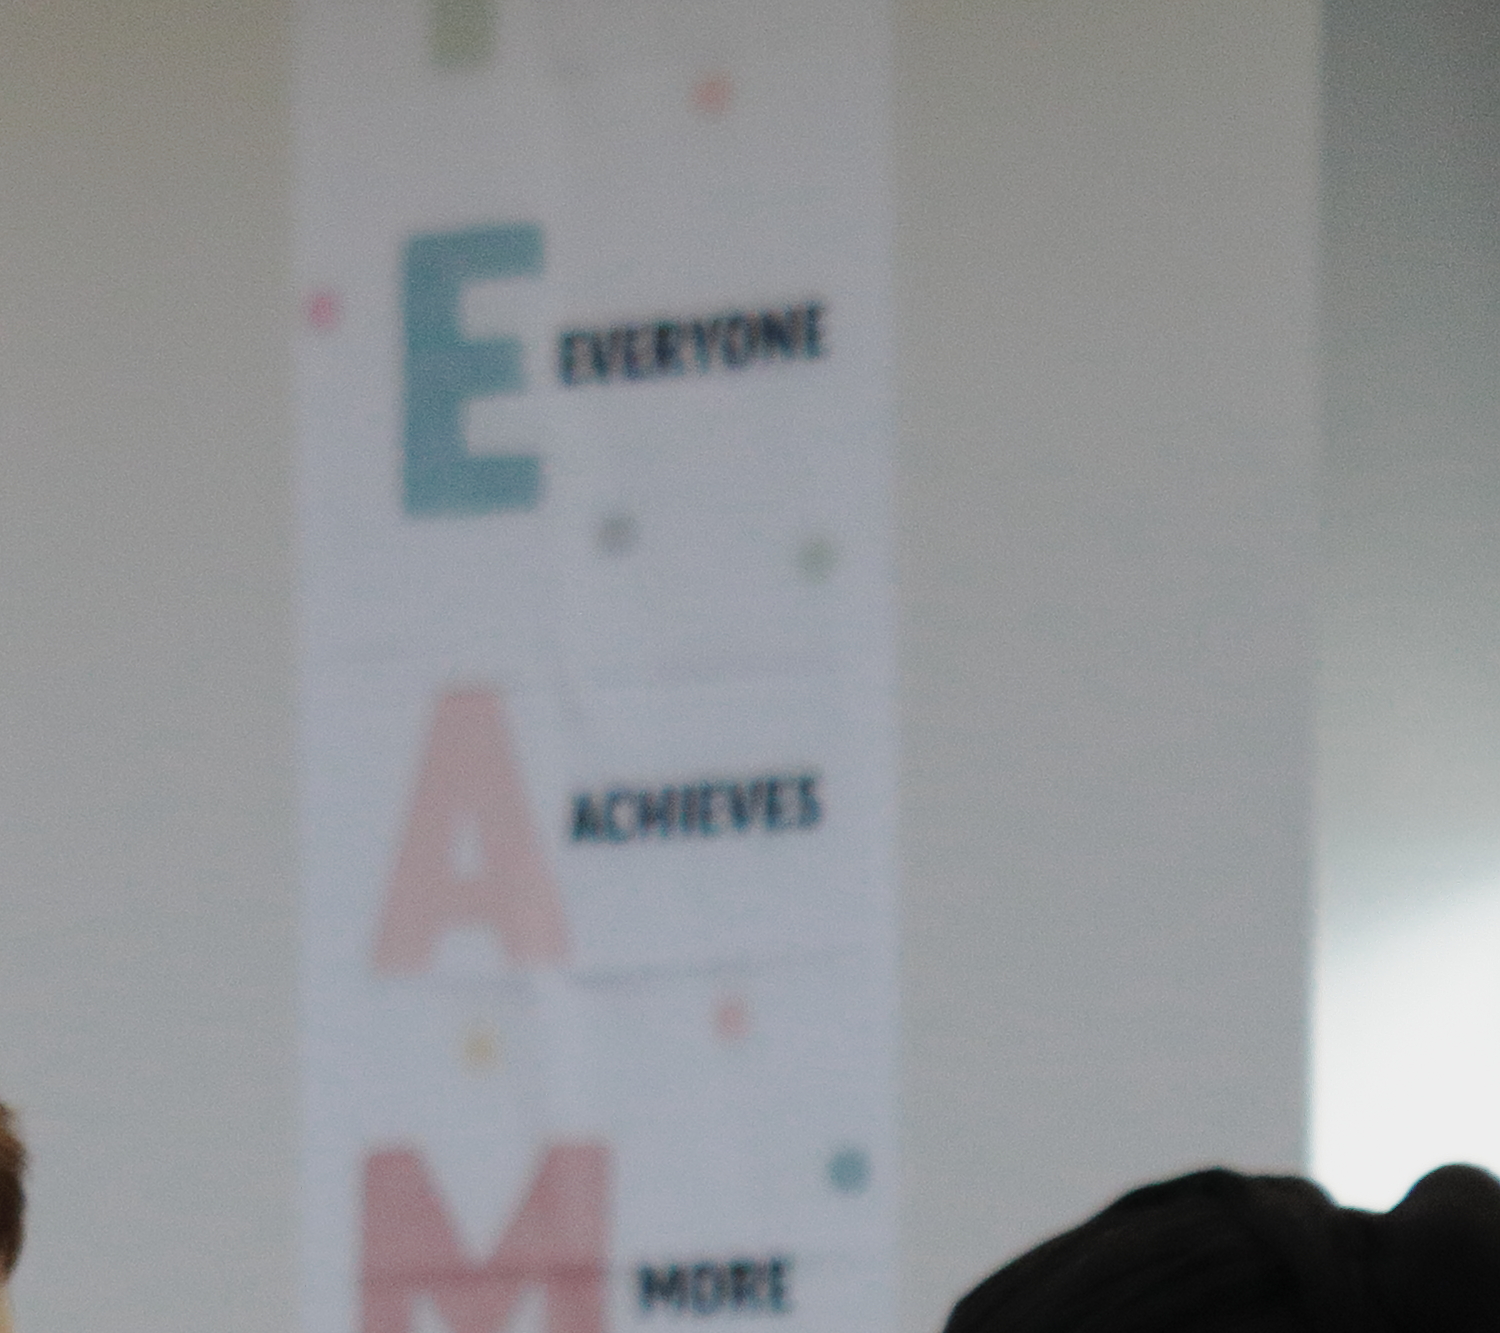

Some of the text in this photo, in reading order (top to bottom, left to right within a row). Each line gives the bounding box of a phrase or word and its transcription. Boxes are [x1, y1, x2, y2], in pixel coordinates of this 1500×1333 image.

[401, 221, 832, 518] E EVERYONE
[369, 682, 824, 977] A ACHIEVES
[637, 1256, 795, 1318] MORE
